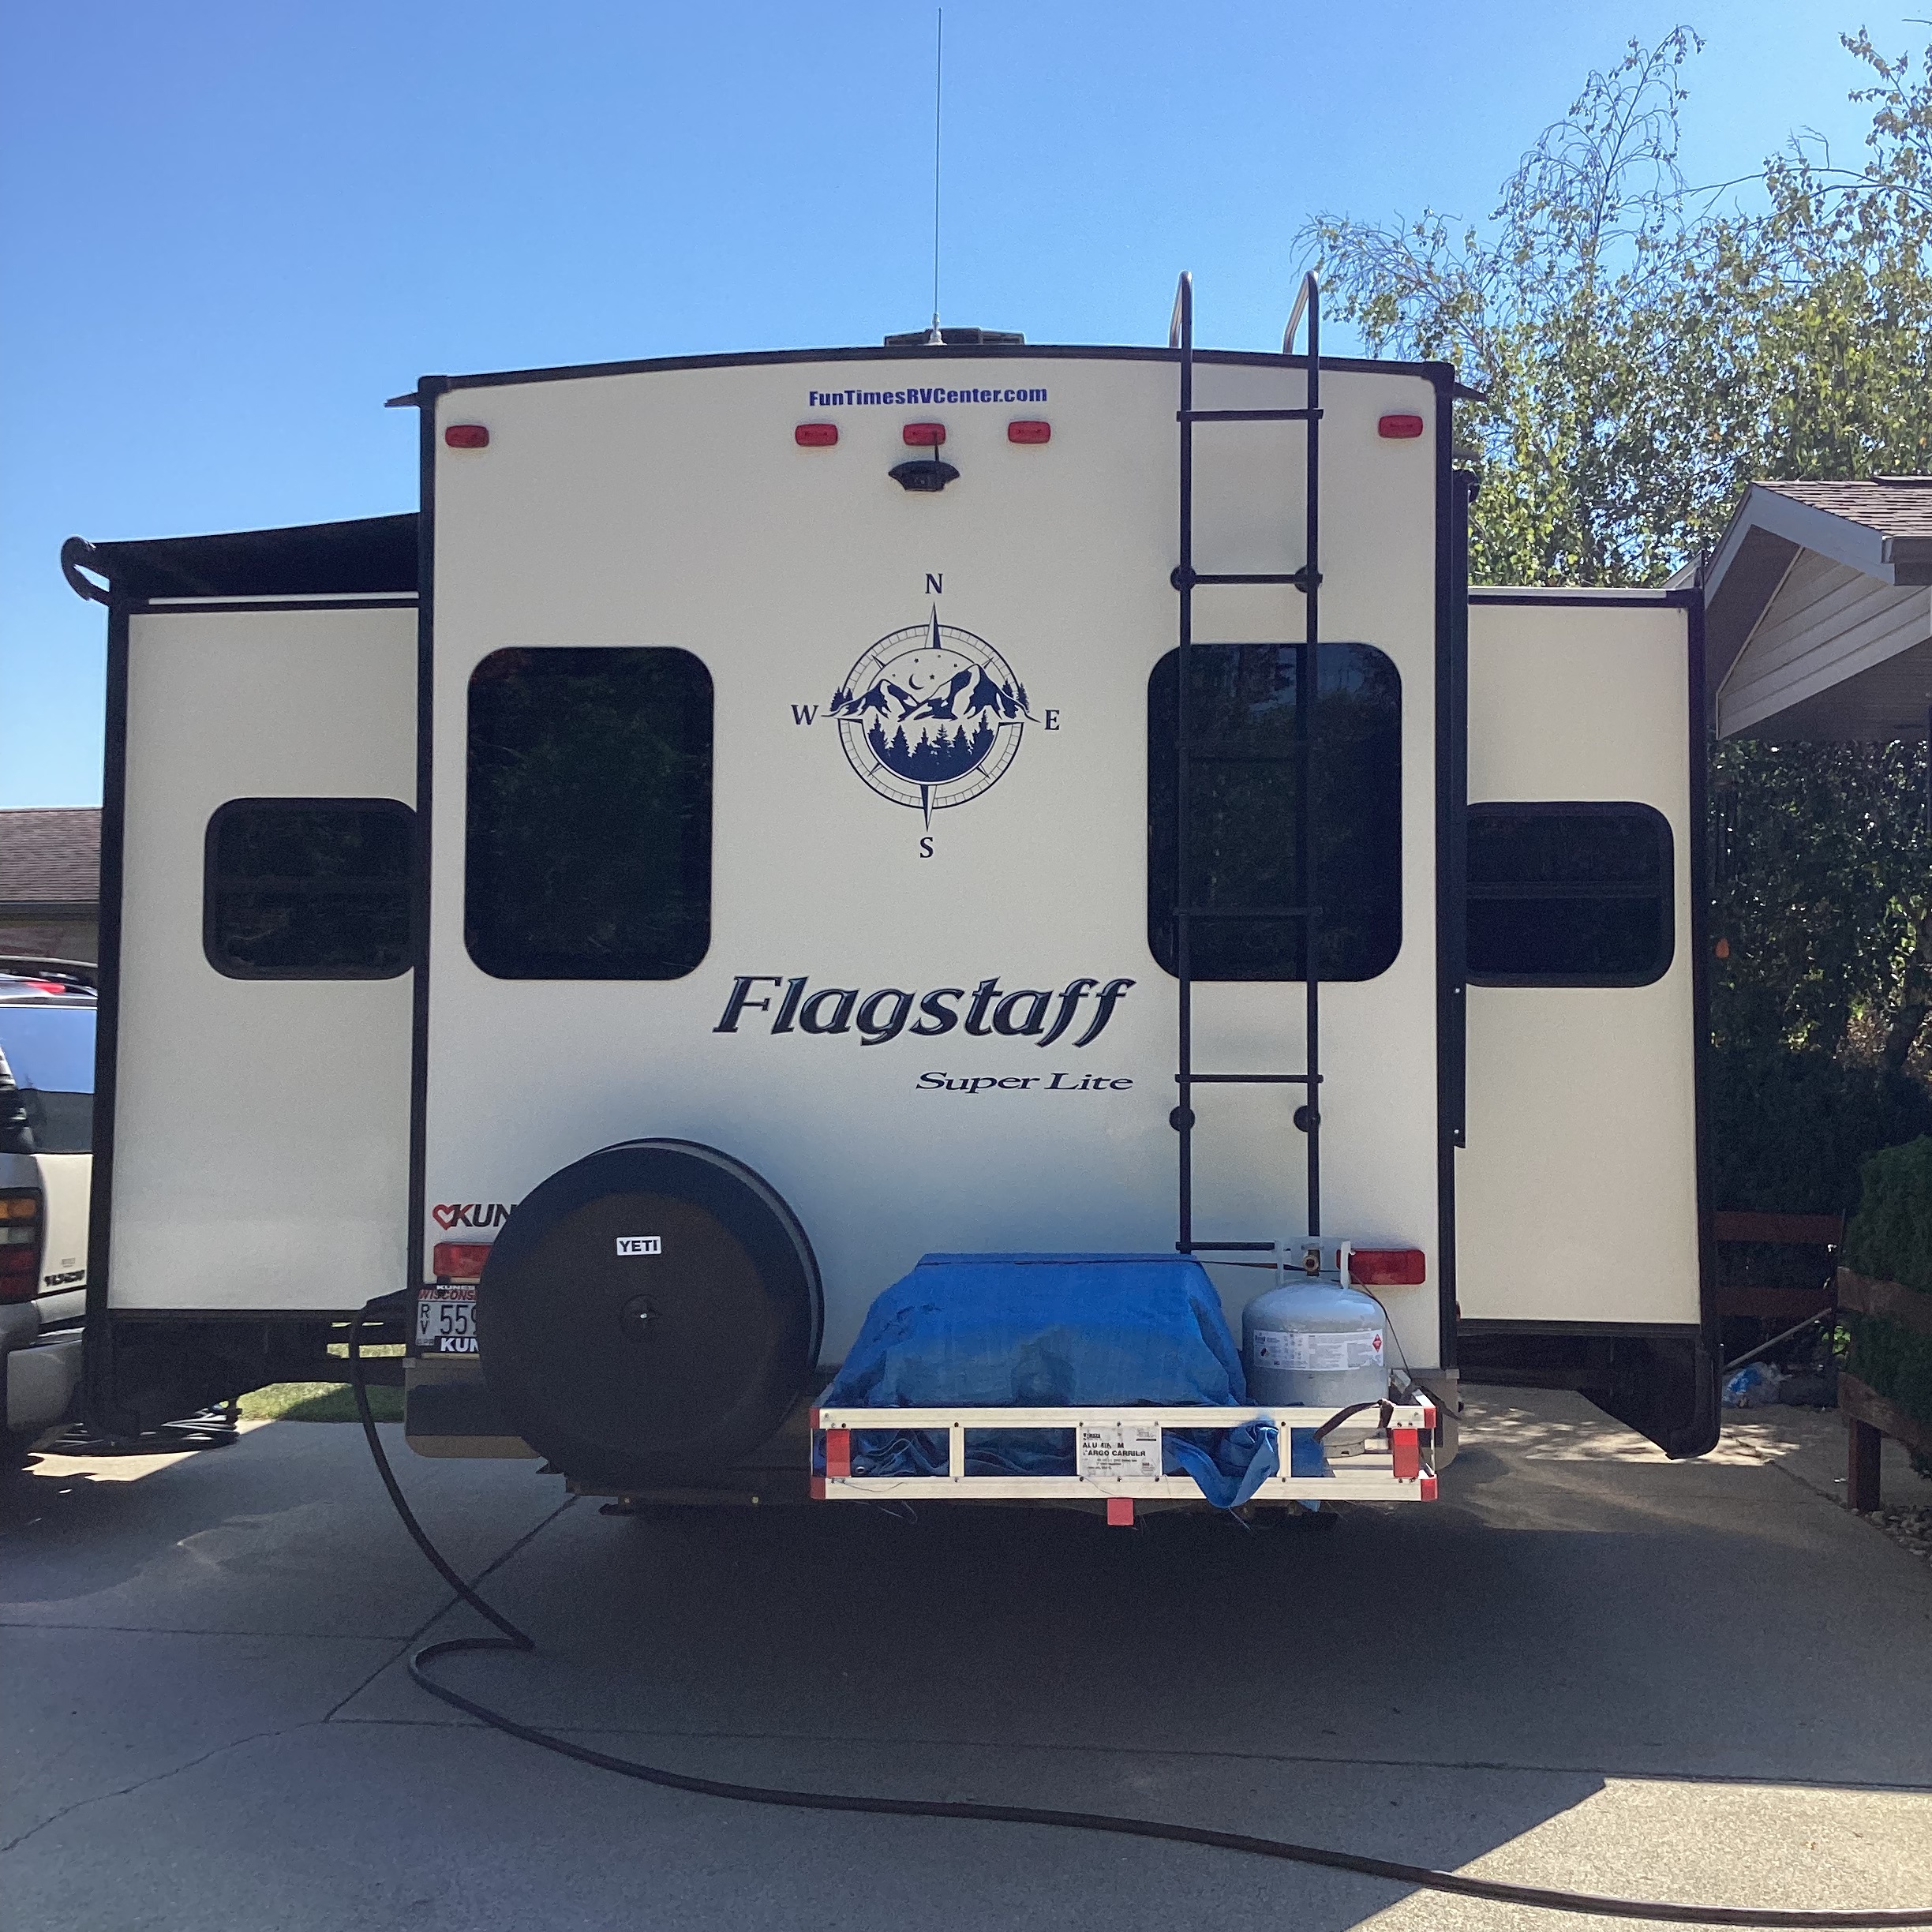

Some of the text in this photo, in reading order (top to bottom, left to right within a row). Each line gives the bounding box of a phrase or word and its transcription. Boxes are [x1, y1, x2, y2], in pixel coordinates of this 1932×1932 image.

[808, 387, 1048, 406] FunTimesRVCenter.com
[924, 573, 943, 594] N
[790, 704, 819, 726] W
[1043, 709, 1061, 731] E
[919, 837, 934, 859] S
[712, 975, 1136, 1048] Flagstaff
[915, 1071, 1134, 1095] Super Lite
[619, 1239, 657, 1252] YETI
